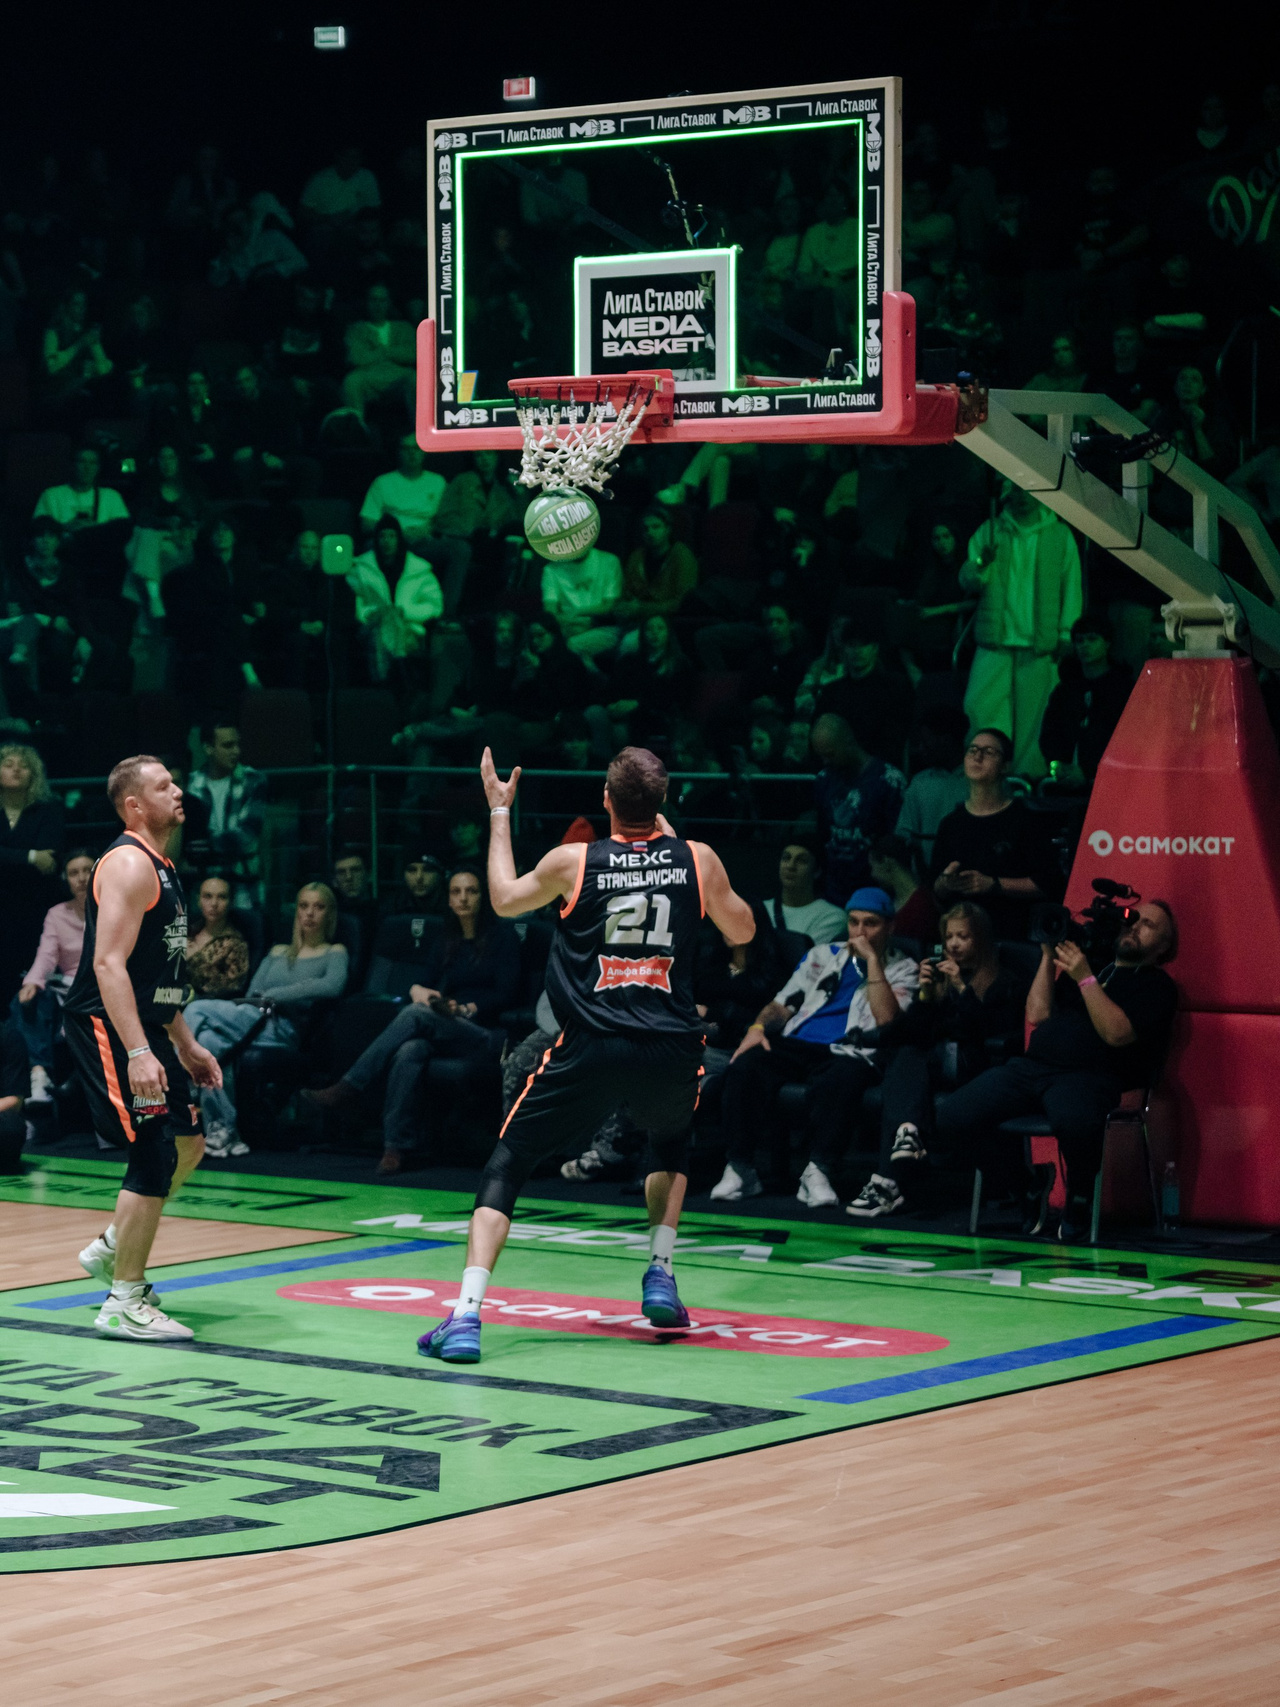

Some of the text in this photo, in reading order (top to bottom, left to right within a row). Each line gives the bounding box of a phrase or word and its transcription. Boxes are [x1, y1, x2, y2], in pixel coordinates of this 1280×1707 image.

[603, 288, 705, 315] ЛИГА СТАВОК
[602, 314, 705, 339] MEDIA
[602, 336, 705, 357] BASKET
[537, 513, 561, 537] LIGA
[547, 521, 598, 554] MEDIA BASKET
[610, 850, 672, 867] MEXC
[597, 868, 688, 890] STANISLAVCHIK
[605, 893, 673, 946] 21
[607, 966, 662, 979] Альфа Банк
[802, 1254, 1280, 1312] BASK
[94, 1376, 580, 1449] СТАВОК
